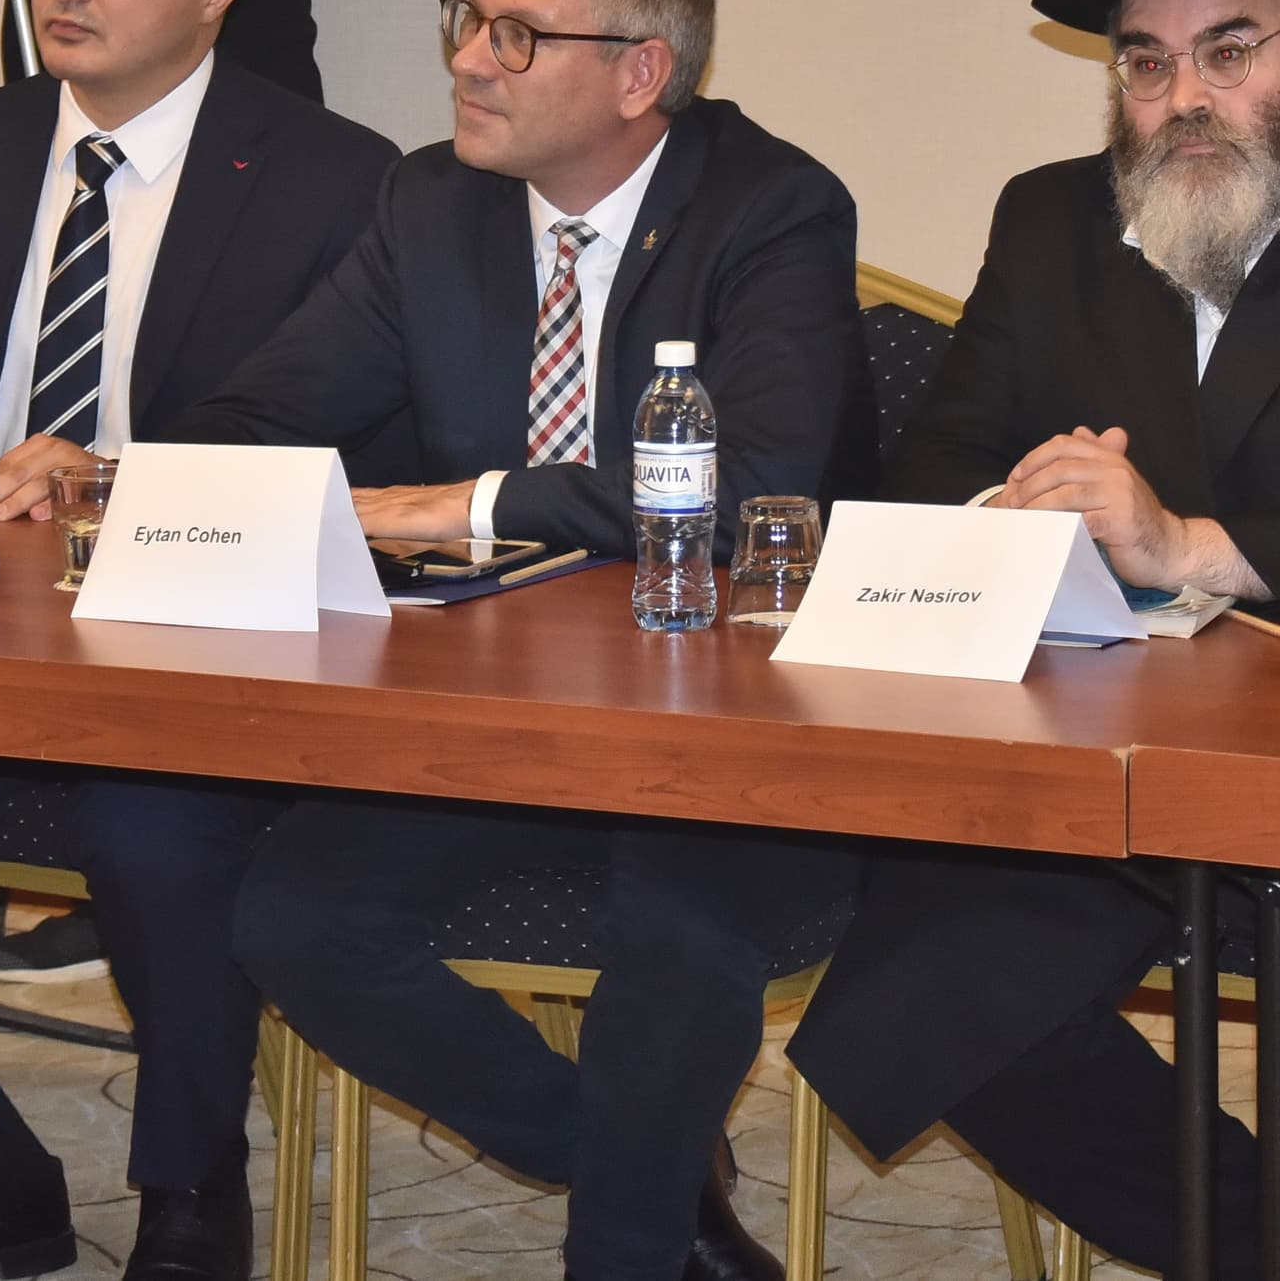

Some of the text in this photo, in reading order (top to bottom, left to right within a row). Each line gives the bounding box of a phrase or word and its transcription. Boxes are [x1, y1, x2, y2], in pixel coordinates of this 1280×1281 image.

[134, 526, 242, 546] Eytan Cohen
[856, 587, 982, 604] Zakir Nəsirov
